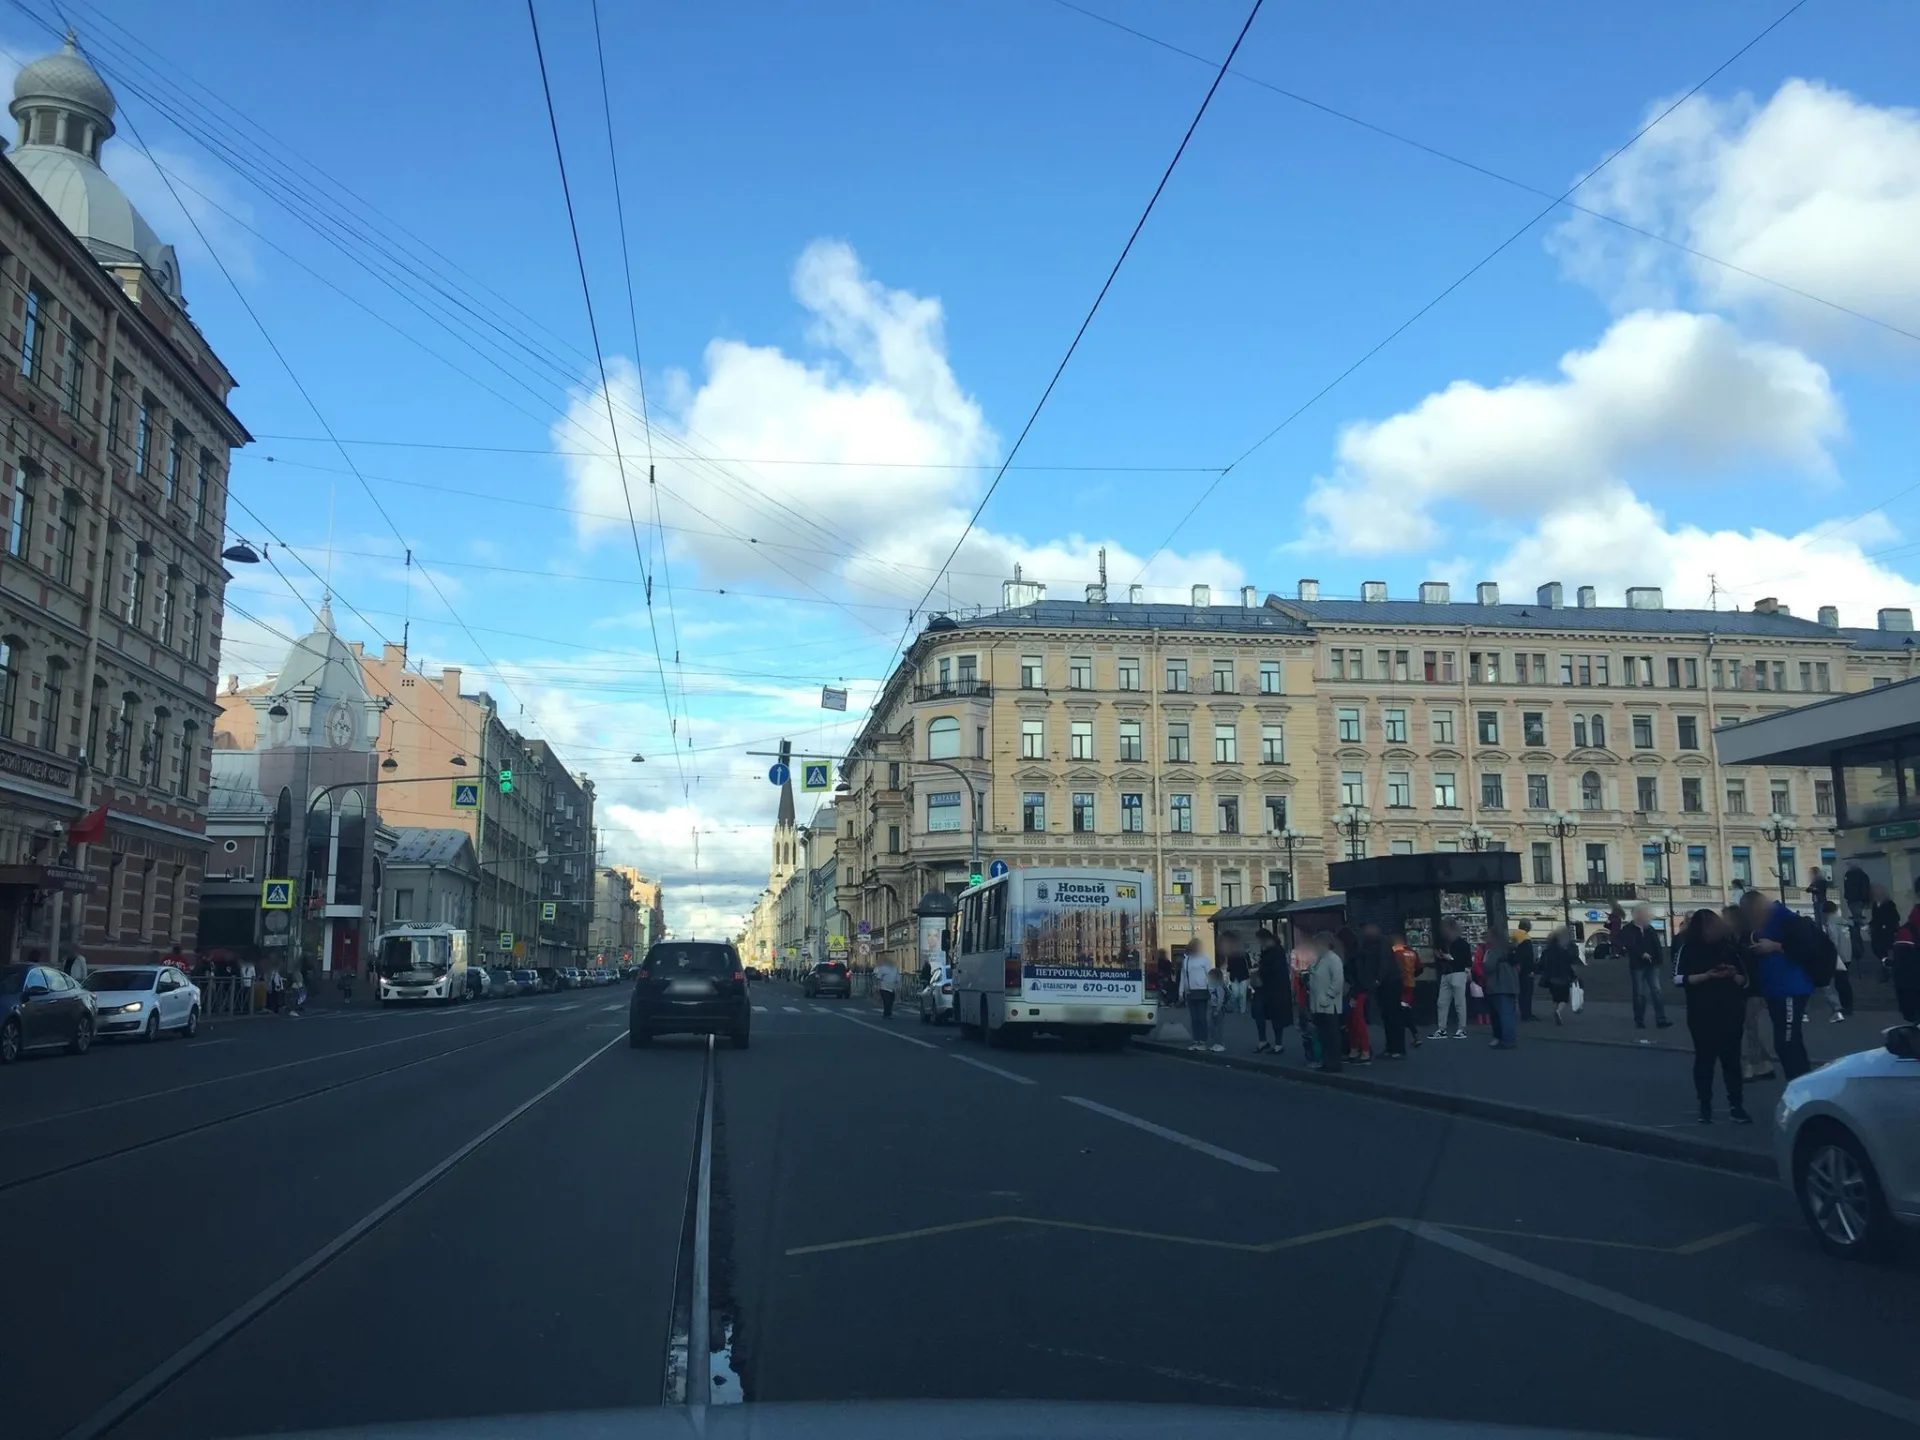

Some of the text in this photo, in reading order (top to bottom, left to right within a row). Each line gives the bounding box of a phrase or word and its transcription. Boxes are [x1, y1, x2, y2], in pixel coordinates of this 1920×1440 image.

[1058, 882, 1106, 893] Новый
[1053, 892, 1110, 906] Лесснер
[1035, 968, 1130, 979] ПЕТРОГРАДКА рядом!
[1083, 983, 1137, 993] 670-01-01
